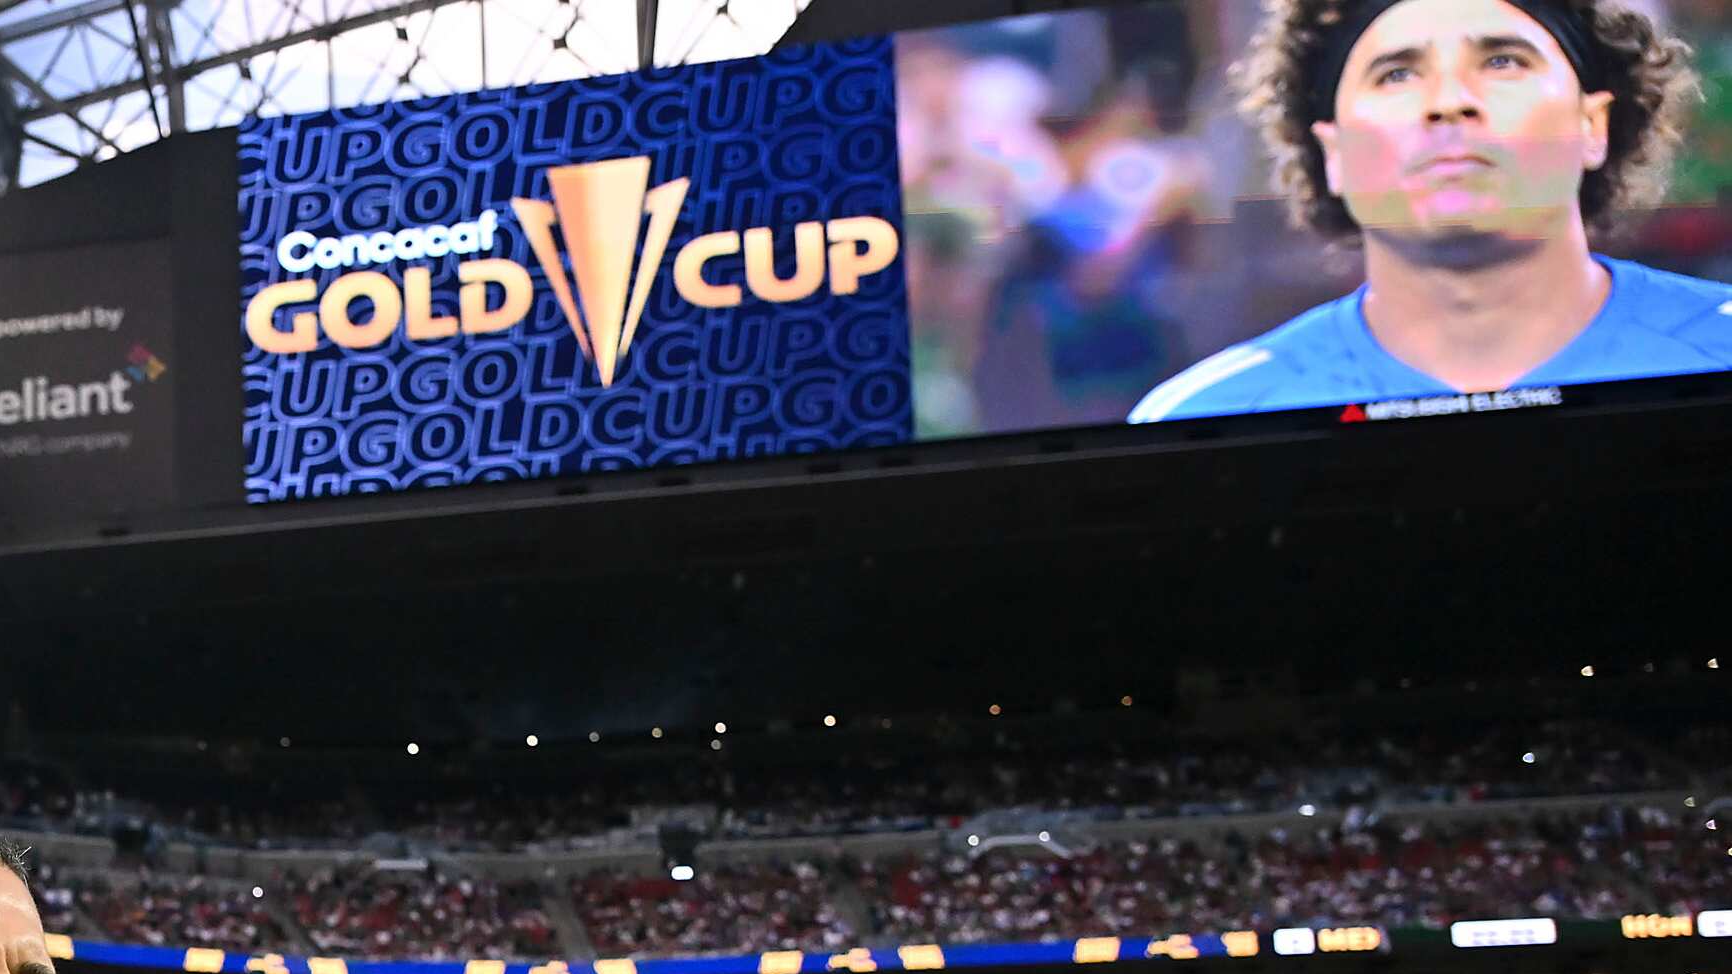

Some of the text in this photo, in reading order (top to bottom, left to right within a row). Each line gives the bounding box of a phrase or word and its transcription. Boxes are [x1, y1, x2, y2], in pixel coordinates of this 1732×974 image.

[277, 209, 500, 272] Concacaf
[245, 215, 899, 354] GOLD CUP
[93, 306, 125, 332] by
